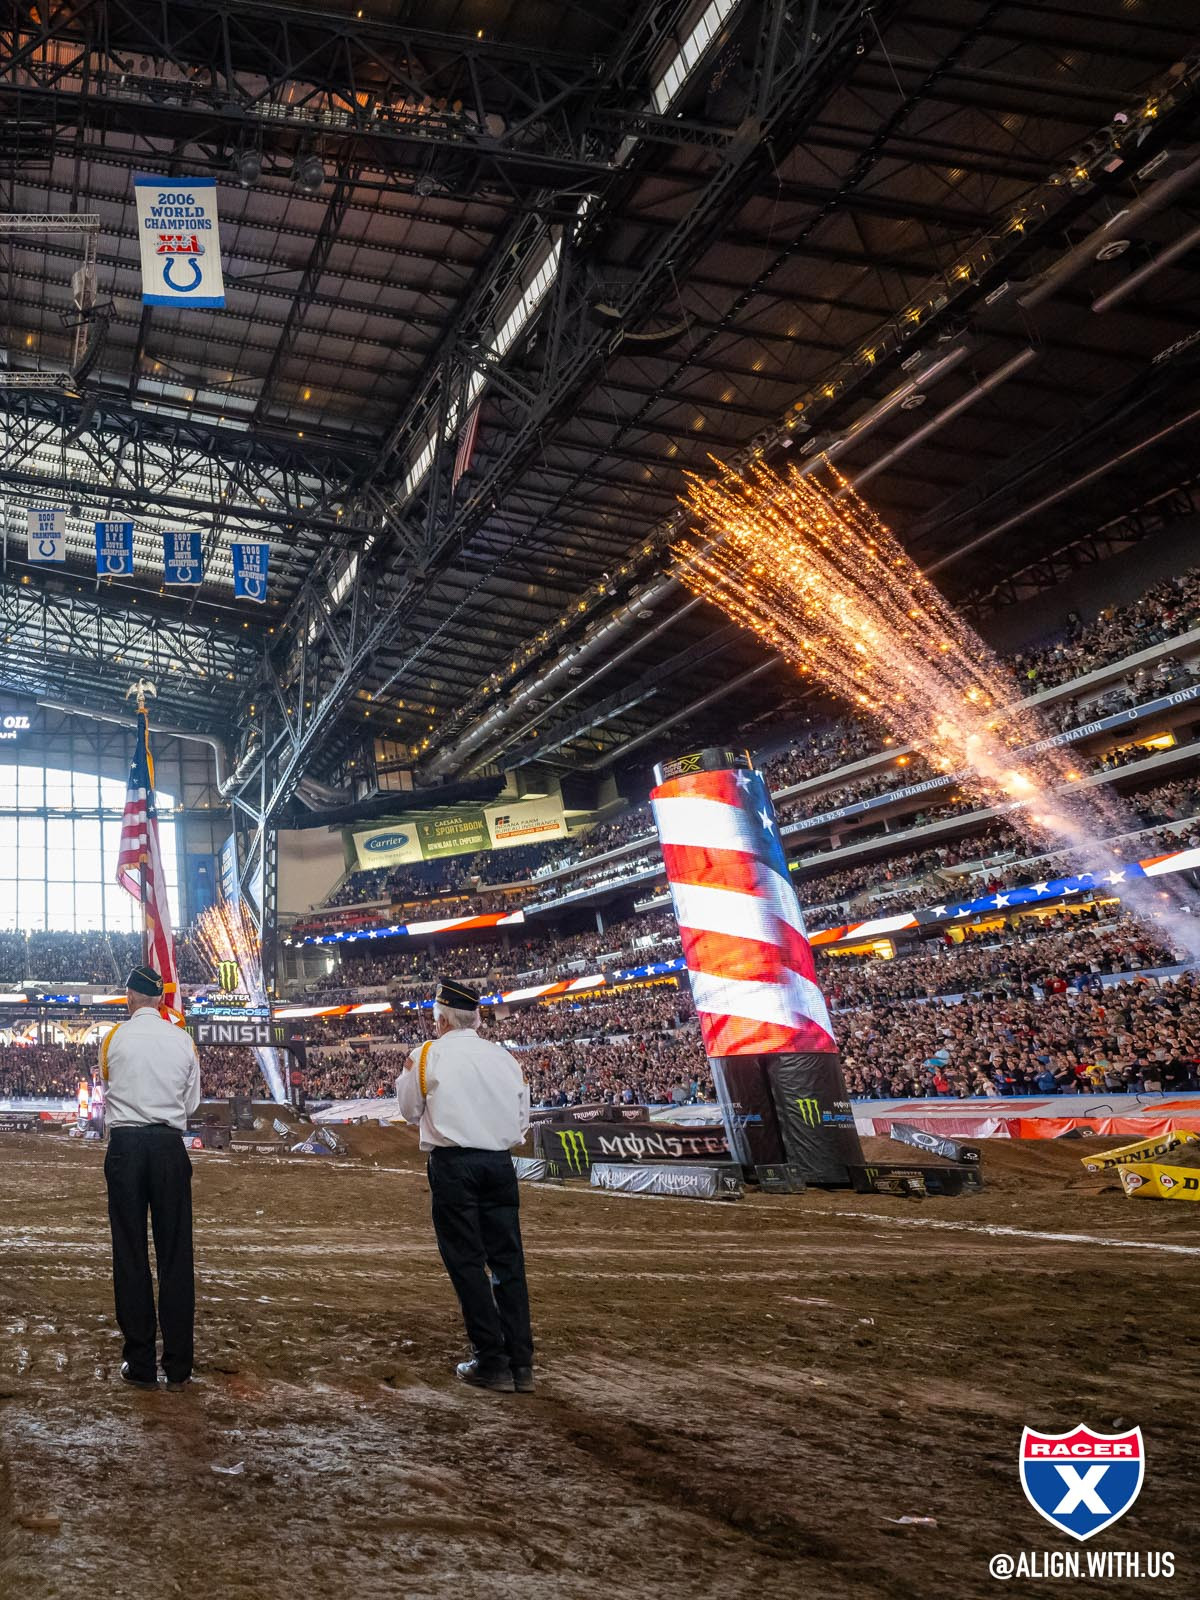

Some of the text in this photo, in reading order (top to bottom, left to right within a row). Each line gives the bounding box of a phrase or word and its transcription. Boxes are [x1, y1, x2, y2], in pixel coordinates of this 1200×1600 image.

[158, 194, 195, 205] 2006
[150, 207, 204, 217] WORLD
[145, 218, 212, 229] CHAMPIONS
[1167, 689, 1198, 705] TONY
[3, 716, 31, 729] OIL
[1035, 723, 1103, 752] COLTS NATION
[889, 776, 951, 801] JIM HARBAUGH
[435, 818, 463, 827] CAESARS
[435, 820, 484, 836] SPORTSBOOK
[521, 820, 559, 830] INSURANCE
[370, 837, 403, 848] Carrier
[208, 993, 251, 1002] MONSTER
[191, 1007, 269, 1016] SUPERCROSS
[198, 1025, 270, 1043] FINISH
[573, 1110, 601, 1120] TRIUMPH
[1103, 1139, 1182, 1170] DUNLOP
[652, 1174, 698, 1186] TRIUMPH
